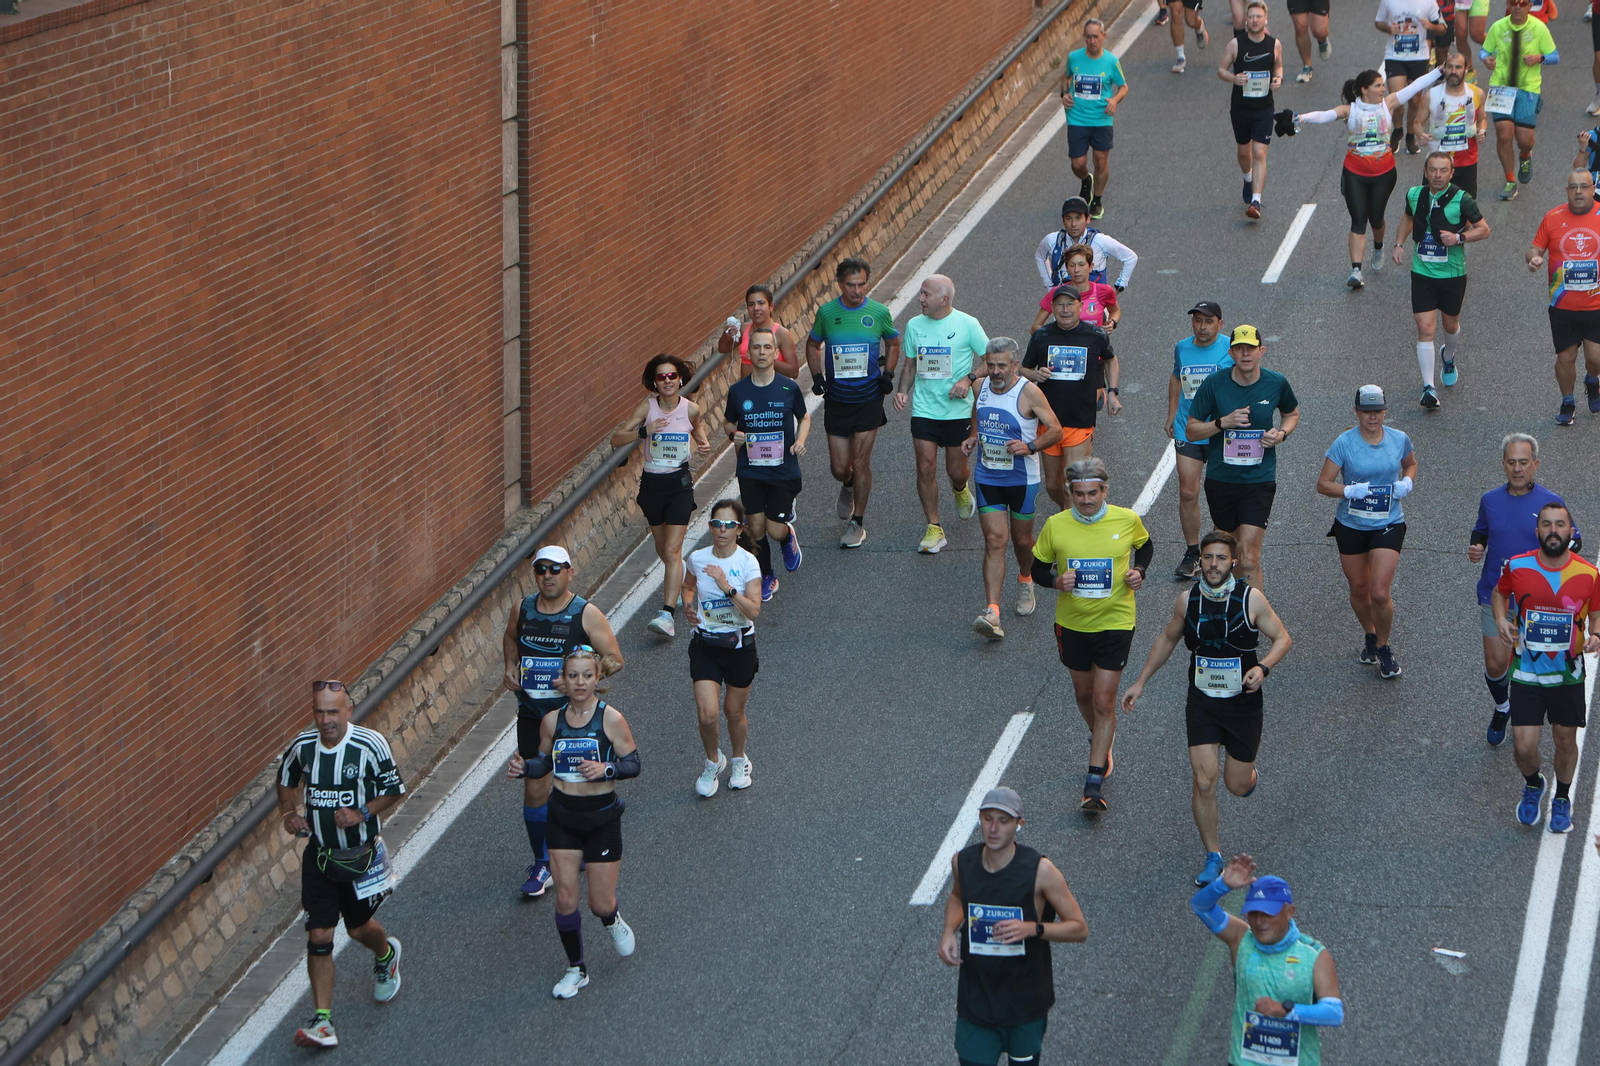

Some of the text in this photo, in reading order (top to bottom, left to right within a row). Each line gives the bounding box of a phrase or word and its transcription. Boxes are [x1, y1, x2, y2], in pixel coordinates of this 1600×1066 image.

[844, 346, 865, 354] ZURICH
[1191, 366, 1213, 374] ZURICH
[744, 411, 784, 423] zapatillas
[979, 419, 1011, 431] eMotion
[983, 427, 1004, 435] running
[758, 434, 780, 442] ZURICH
[988, 437, 1008, 447] ZURIC
[986, 448, 1002, 456] 11042
[1081, 574, 1099, 582] 11521
[1542, 615, 1568, 623] ZURICH
[1539, 627, 1559, 636] 12515
[525, 635, 567, 645] METAESPORT
[1210, 660, 1235, 668] ZURICH
[534, 674, 552, 682] 12307
[1210, 674, 1226, 682] 8994
[1207, 682, 1229, 690] GABRIEL
[568, 741, 592, 750] ZURICH
[308, 786, 340, 799] Team
[985, 909, 1015, 919] ZURICH
[1262, 1018, 1294, 1030] ZURICH
[1249, 1042, 1265, 1053] JOSE
